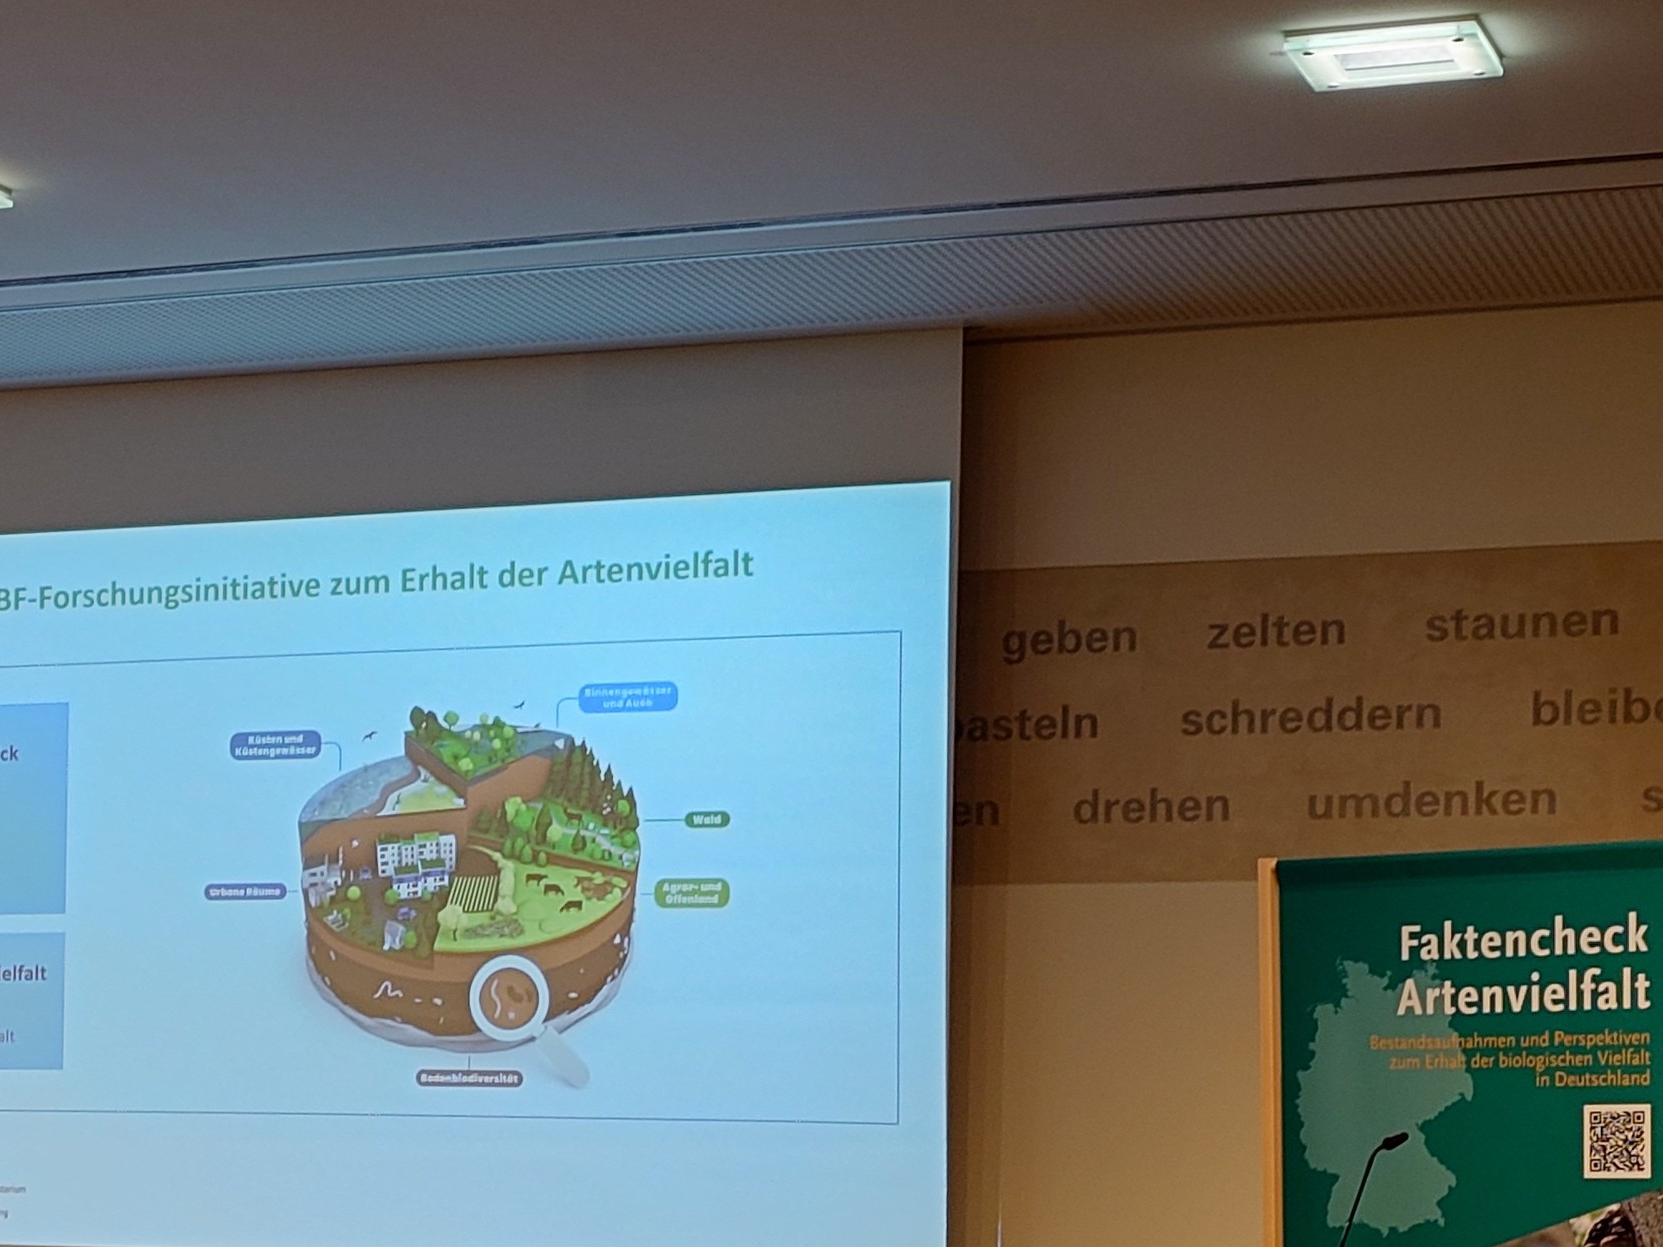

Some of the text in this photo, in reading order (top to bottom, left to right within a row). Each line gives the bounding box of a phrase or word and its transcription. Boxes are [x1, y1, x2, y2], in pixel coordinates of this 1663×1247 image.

[330, 571, 390, 595] zum
[401, 563, 488, 592] Erhalt
[498, 560, 548, 588] der
[557, 548, 754, 585] Artenvielfalt
[1002, 607, 1620, 666] geben zelten staunen
[1181, 696, 1441, 737] schreddern
[693, 814, 722, 825] Wald
[1073, 787, 1230, 825] drehen
[1307, 780, 1557, 820] umdenken
[1400, 911, 1649, 962] Faktencheck
[1396, 966, 1651, 1016] Artenvielfalt
[1369, 1029, 1651, 1050] Bestandsaufnahmen und Perspektiven
[1389, 1048, 1650, 1072] zum Erhalt der biologischen Vielfalt
[1536, 1069, 1651, 1087] in Deutschland
